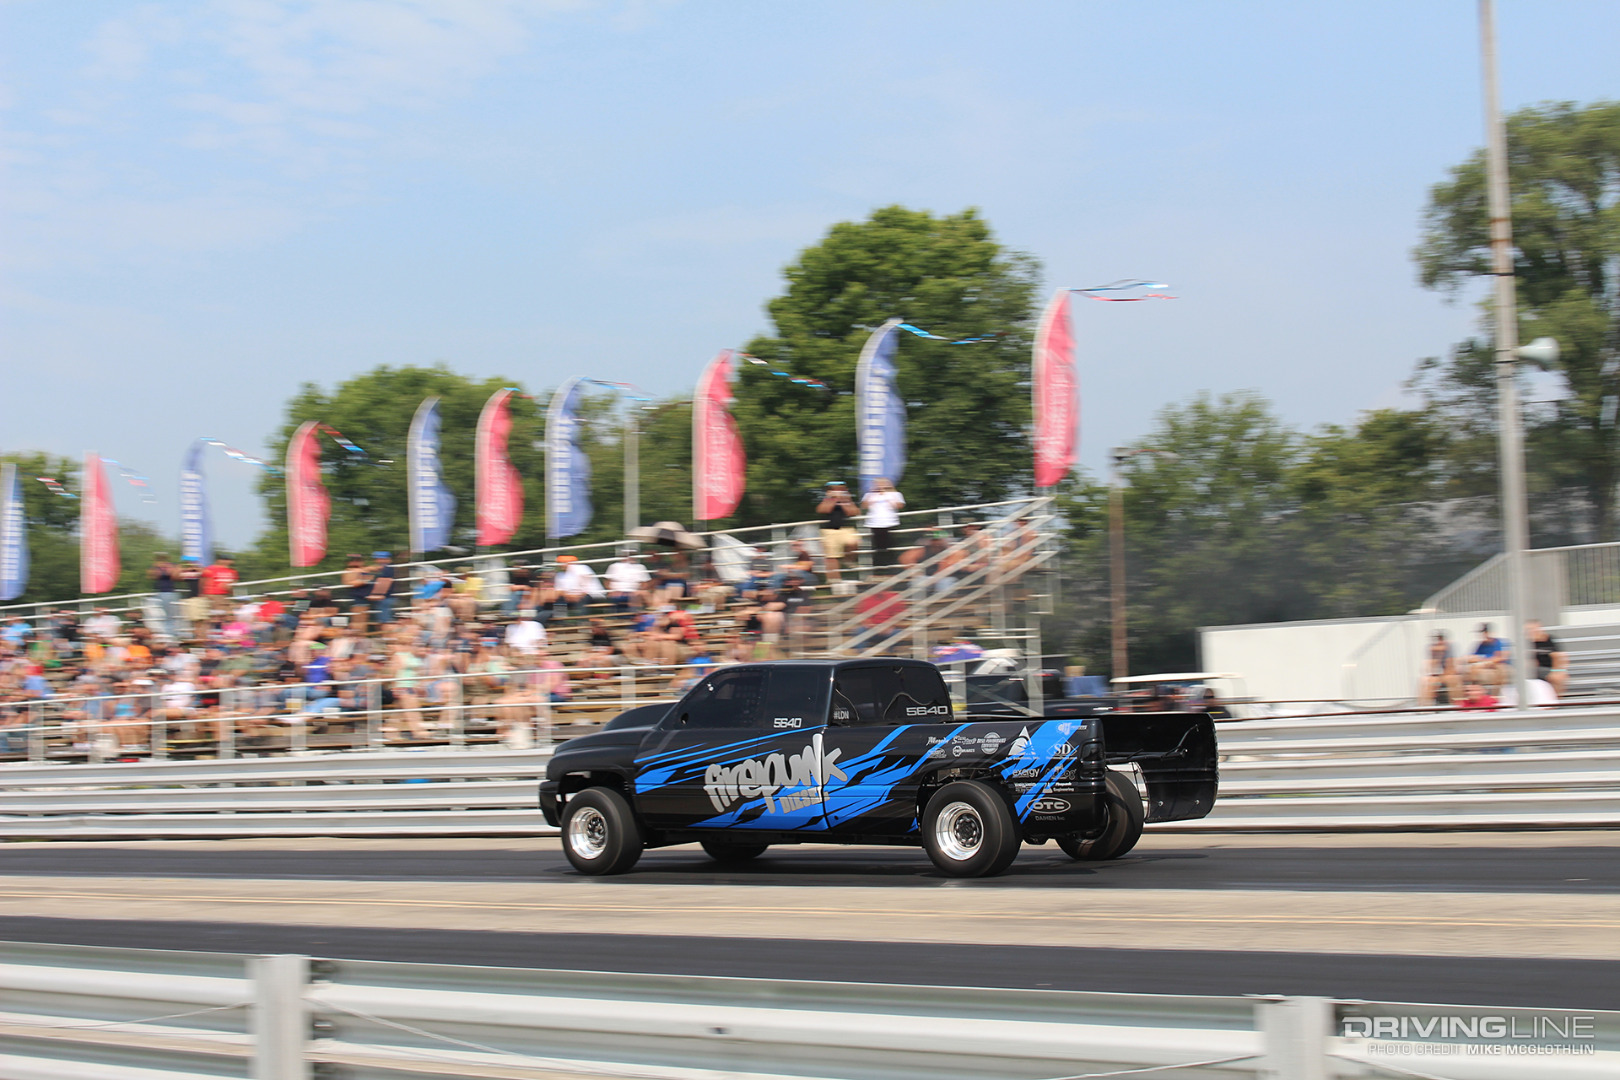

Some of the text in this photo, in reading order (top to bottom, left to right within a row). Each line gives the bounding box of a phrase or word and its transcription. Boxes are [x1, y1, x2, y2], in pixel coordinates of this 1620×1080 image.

[906, 705, 948, 716] 5640
[774, 717, 802, 728] 5640
[1012, 769, 1040, 778] exergy
[1033, 802, 1065, 810] OTC
